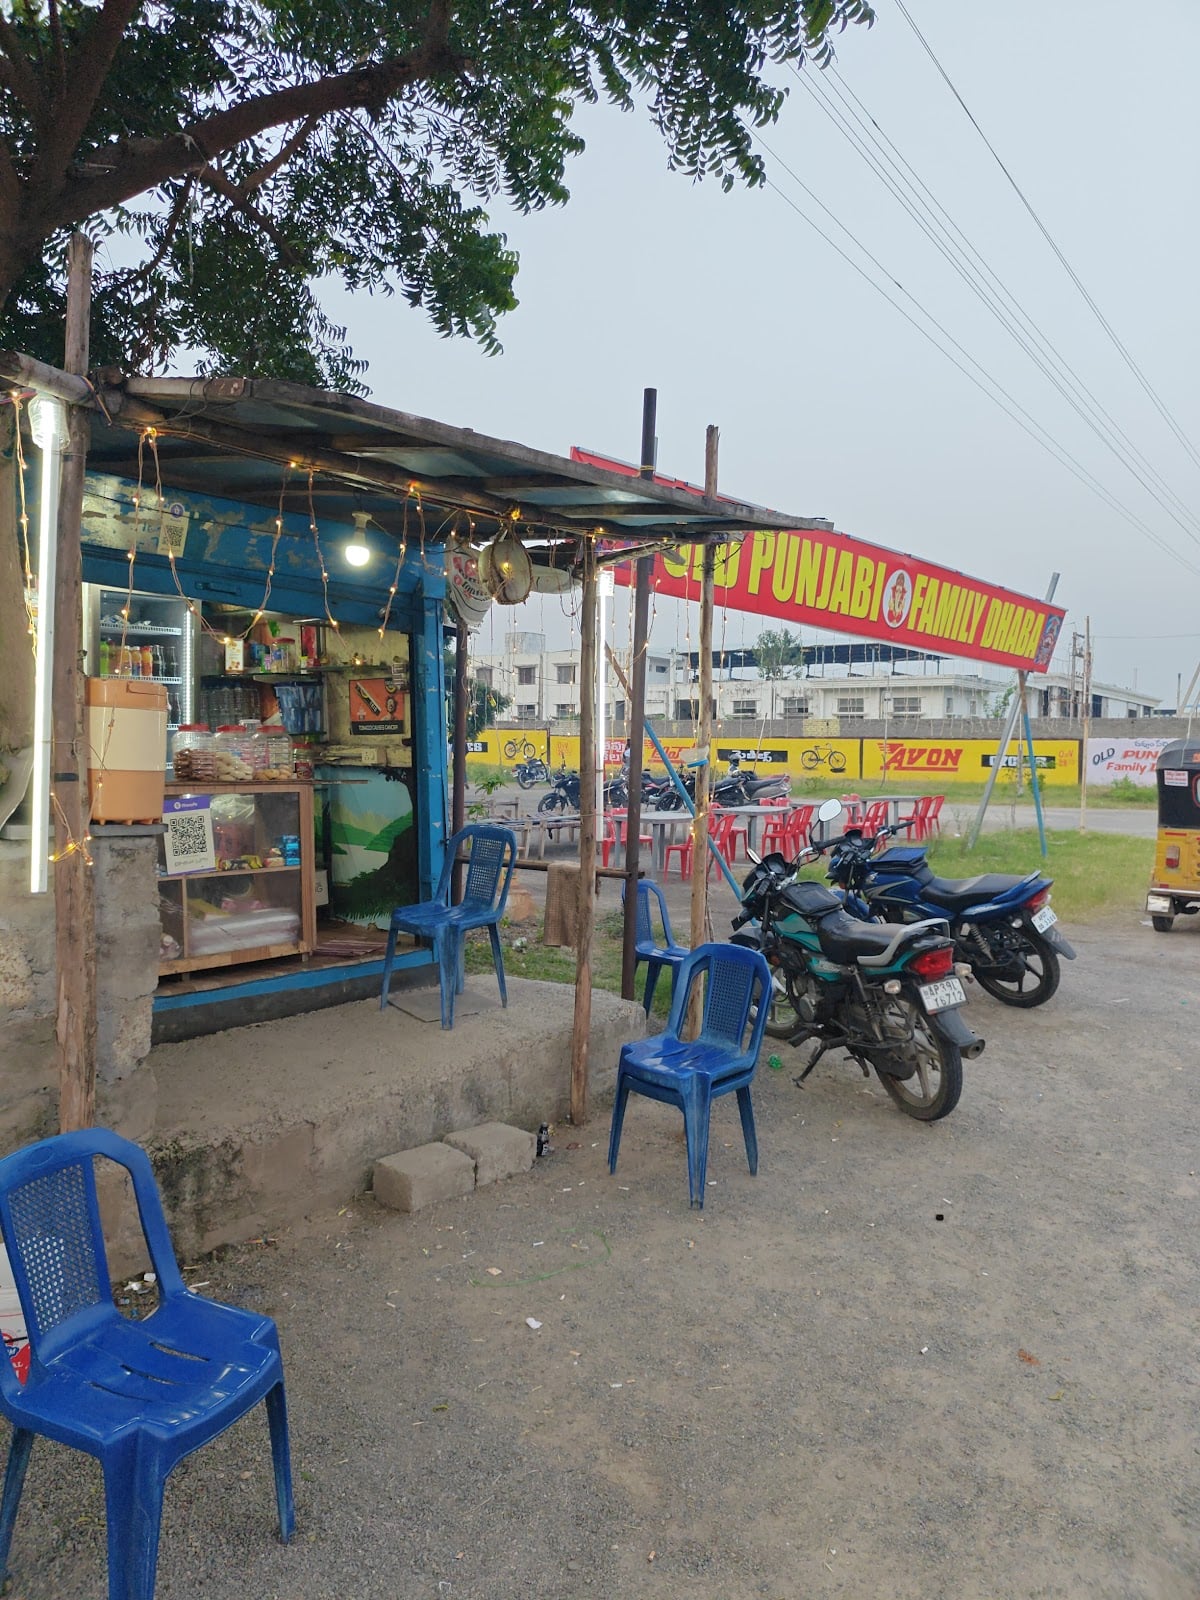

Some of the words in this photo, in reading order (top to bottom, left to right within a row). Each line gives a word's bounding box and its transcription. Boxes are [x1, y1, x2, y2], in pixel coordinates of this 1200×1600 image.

[748, 530, 887, 623] PUNJABI
[907, 573, 987, 644] FAMILY
[980, 599, 1046, 660] DHABA
[880, 747, 963, 770] AVON
[1093, 747, 1115, 765] OLD
[1106, 762, 1147, 775] Family
